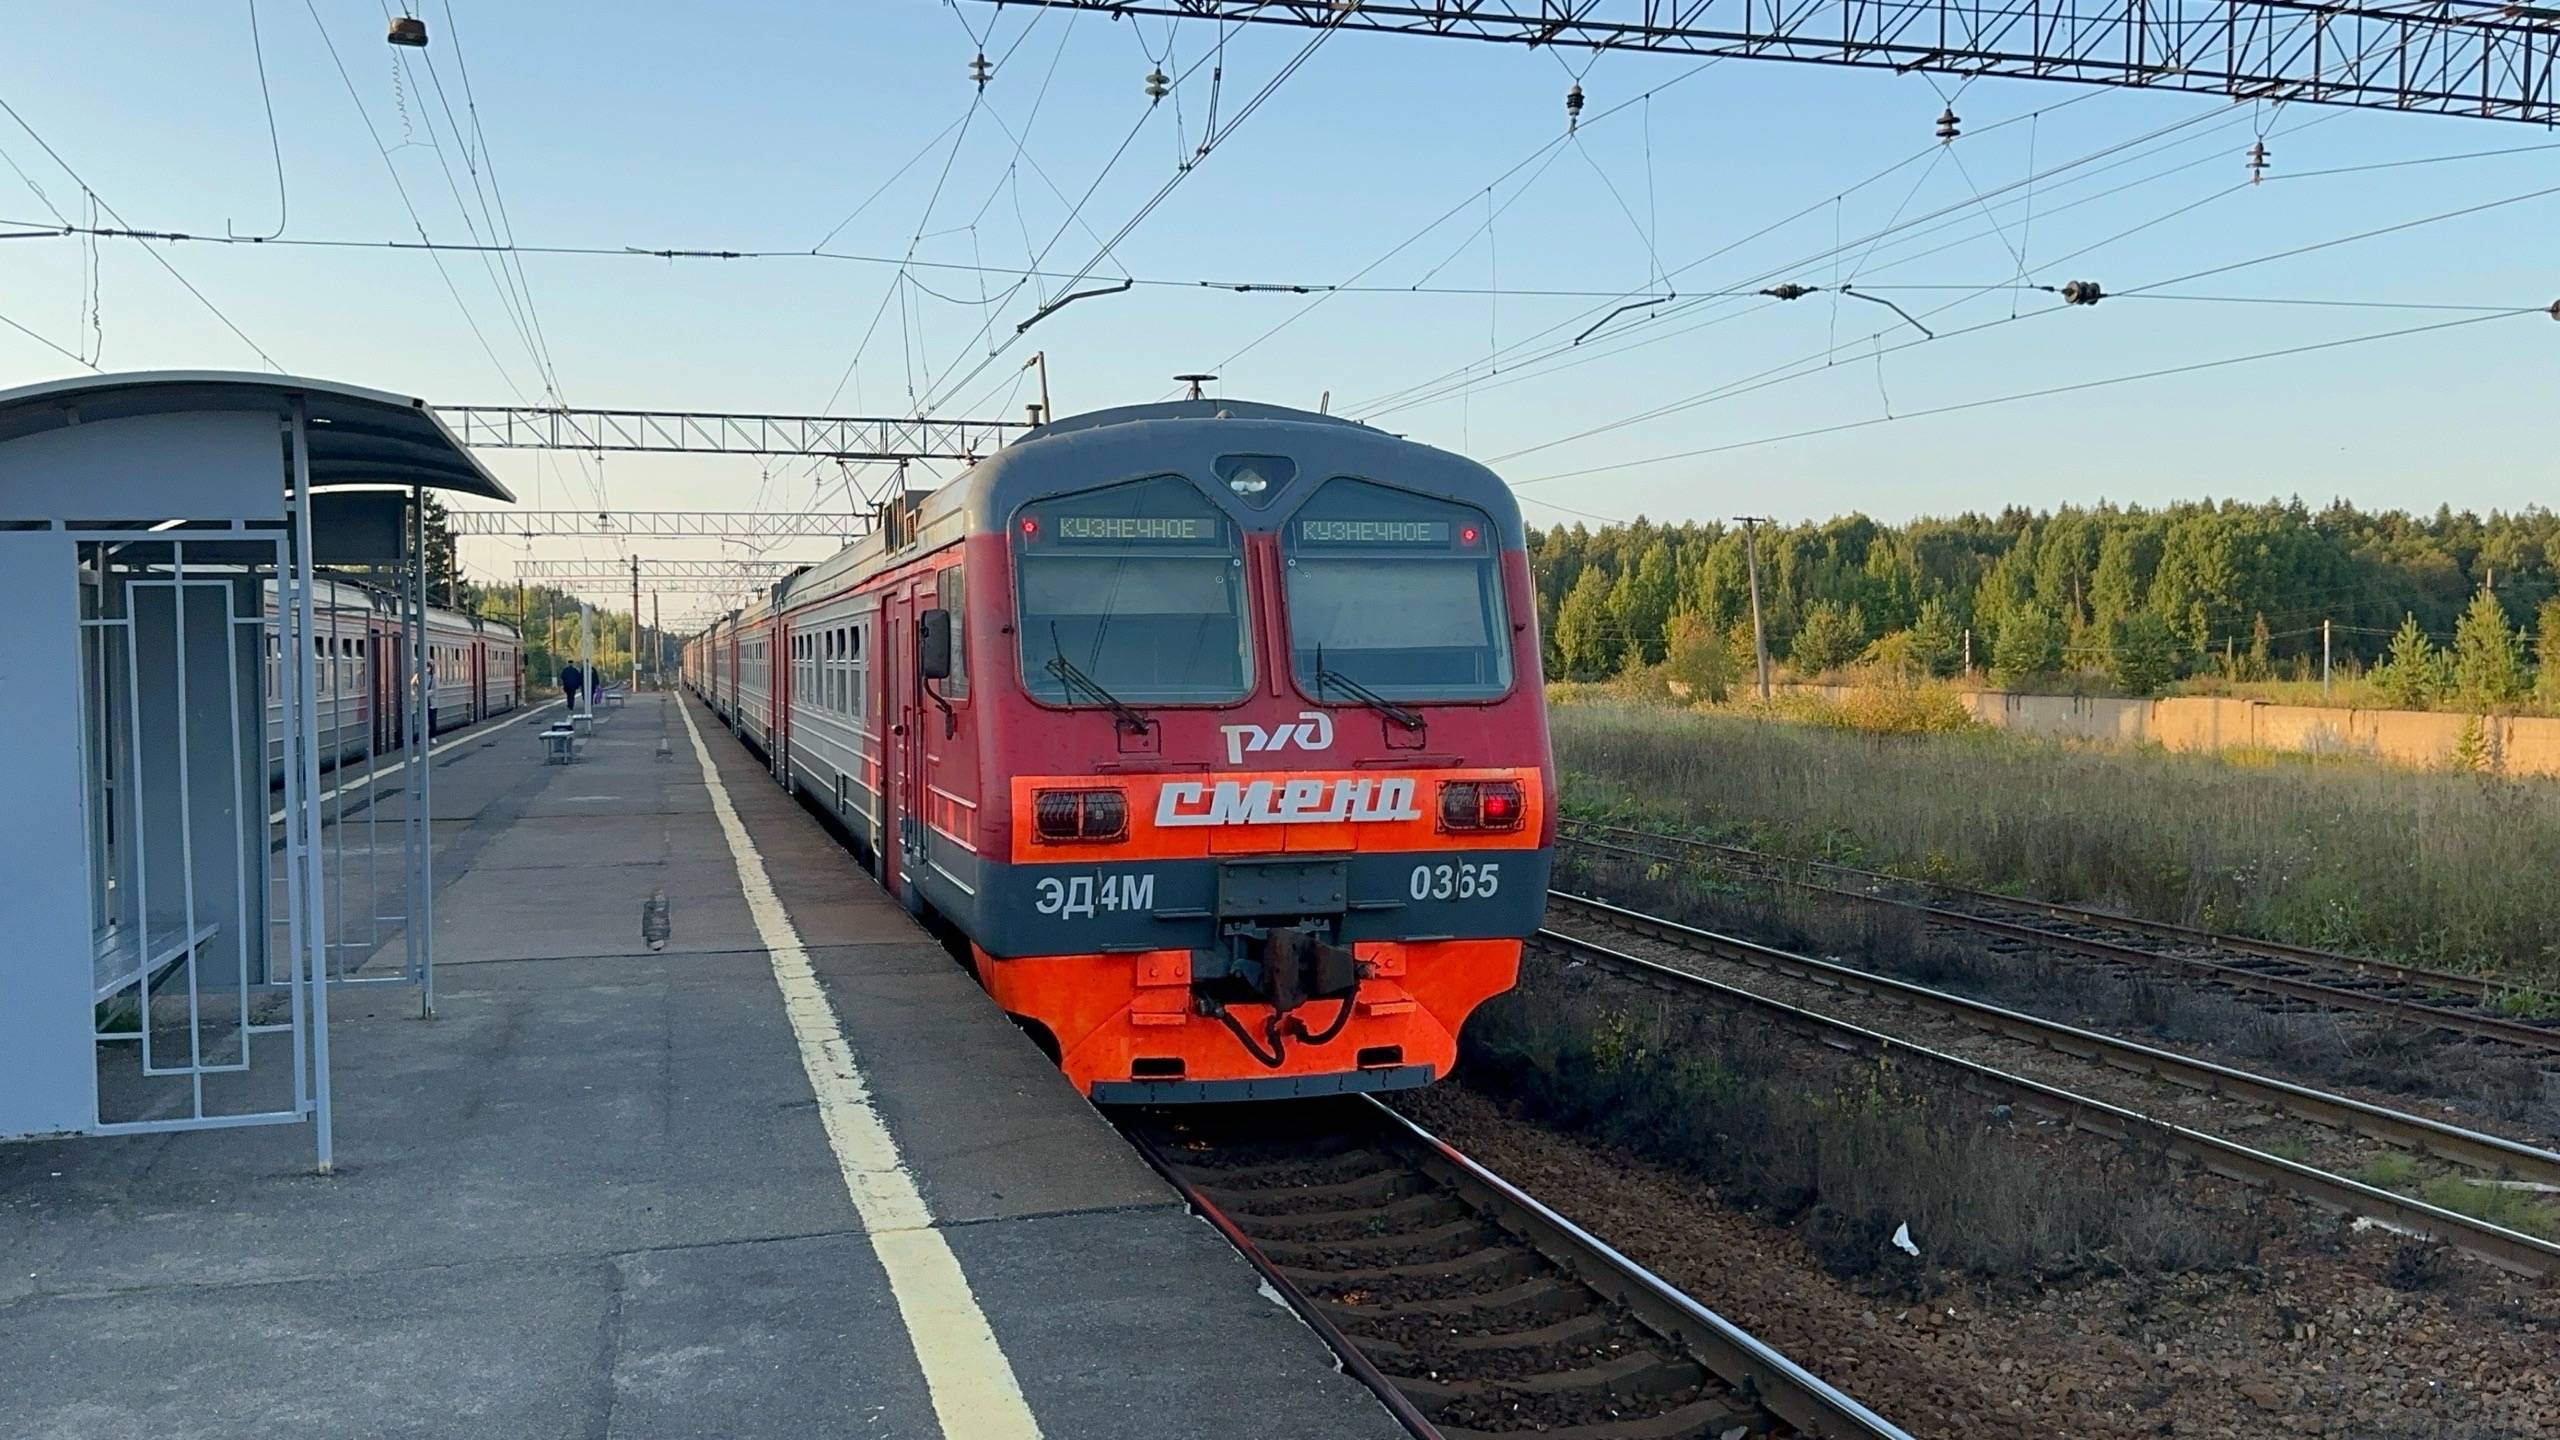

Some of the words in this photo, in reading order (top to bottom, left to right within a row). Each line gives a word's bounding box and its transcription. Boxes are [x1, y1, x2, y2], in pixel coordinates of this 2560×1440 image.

[1060, 518, 1197, 538] КУЗНЕЧНОЕ
[1303, 521, 1432, 541] КУЗНЕЧНОЕ
[1410, 863, 1499, 900] 0365
[1035, 874, 1154, 920] ЭД4М
